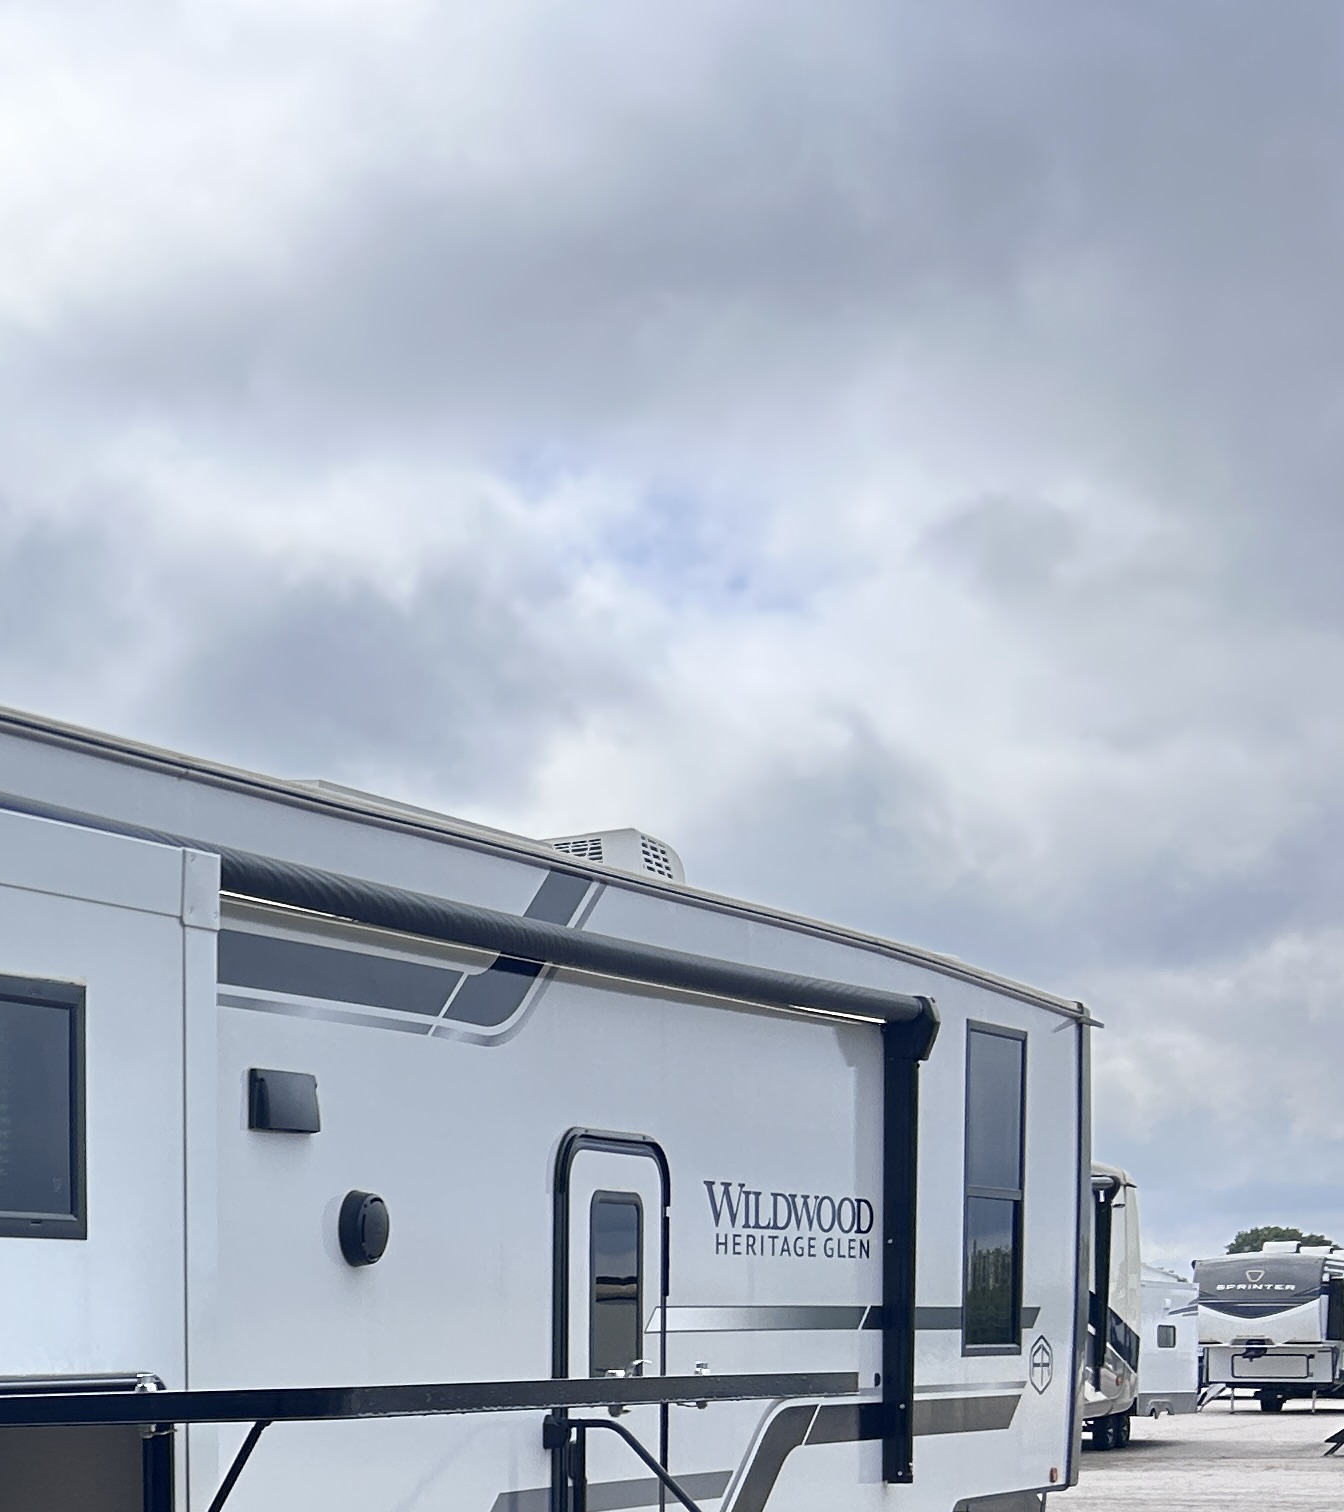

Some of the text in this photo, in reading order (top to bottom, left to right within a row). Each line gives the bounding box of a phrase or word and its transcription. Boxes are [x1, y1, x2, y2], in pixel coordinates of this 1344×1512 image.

[703, 1180, 874, 1235] WILDWOOD
[715, 1233, 870, 1260] HERITAGE GLEN
[1215, 1283, 1296, 1291] SPRINTER
